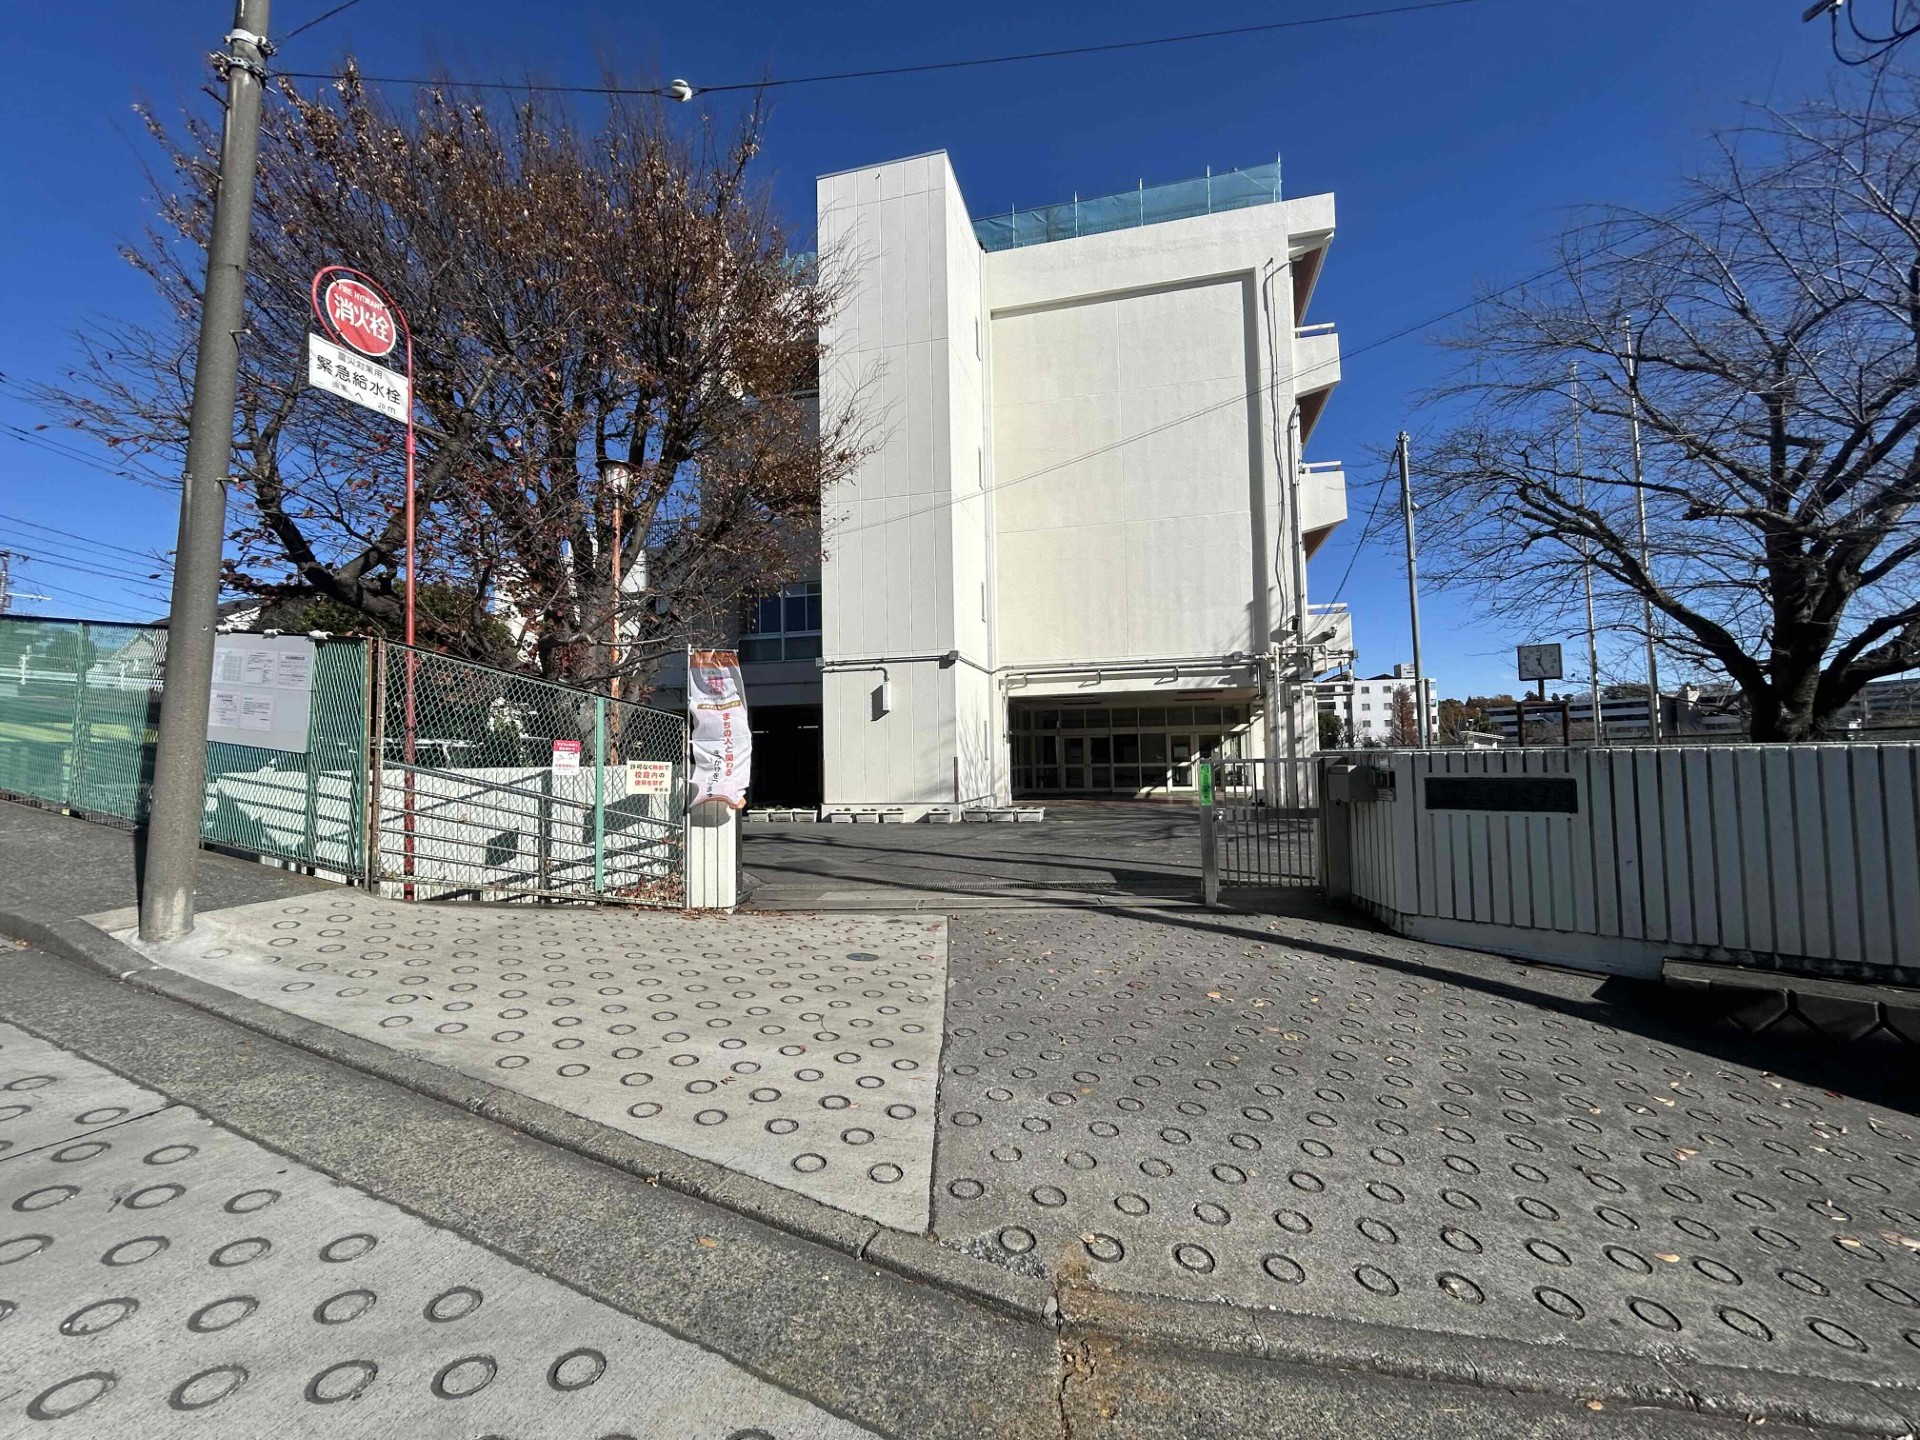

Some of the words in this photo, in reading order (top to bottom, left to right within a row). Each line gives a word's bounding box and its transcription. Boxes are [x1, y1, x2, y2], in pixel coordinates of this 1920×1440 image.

[333, 292, 390, 343] 消火栓
[316, 354, 401, 406] 緊急給水栓
